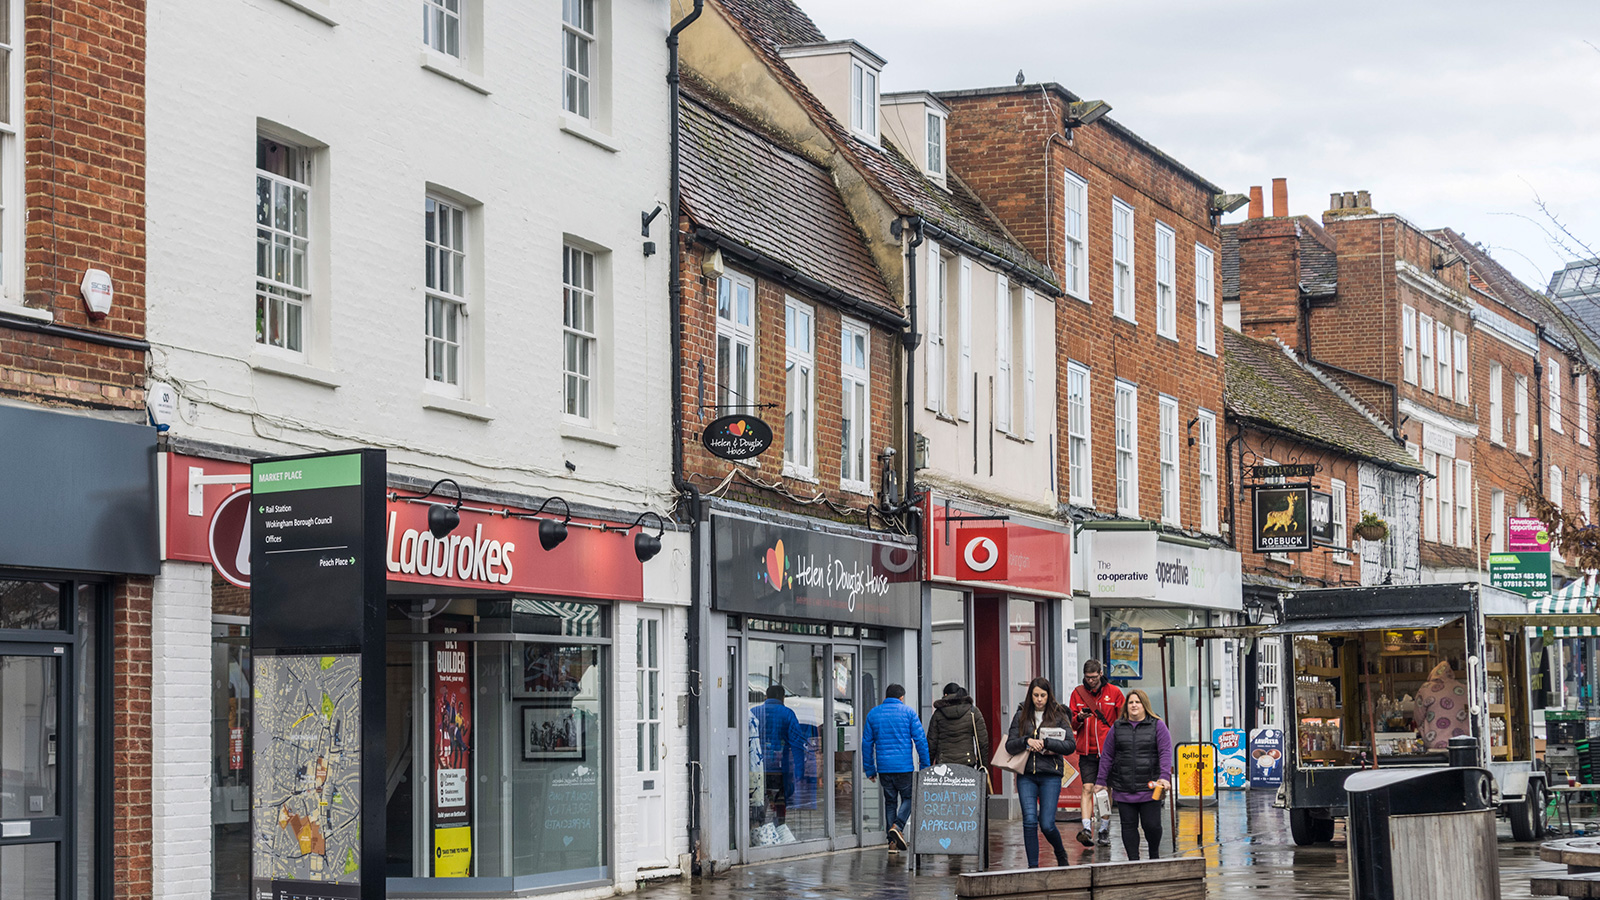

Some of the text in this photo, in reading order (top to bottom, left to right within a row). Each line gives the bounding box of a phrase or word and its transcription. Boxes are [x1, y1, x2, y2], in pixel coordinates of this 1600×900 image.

[710, 437, 763, 452] Helen & Douglas
[258, 470, 302, 483] MARKET PLACE
[275, 505, 292, 513] Station
[265, 516, 333, 529] Wokingham Borough Council
[265, 535, 282, 543] Offices
[1261, 536, 1303, 545] ROEBUCK
[387, 511, 515, 584] Ladbrokes
[319, 558, 348, 567] Peach Place
[1097, 560, 1111, 570] The
[1097, 571, 1149, 582] co-operative
[1155, 558, 1189, 589] -operative
[796, 554, 824, 589] Helen
[826, 554, 833, 597] &
[834, 559, 864, 612] Douglas
[865, 564, 889, 596] House
[1098, 583, 1115, 593] food
[437, 651, 466, 673] BUILDER
[1182, 752, 1209, 760] Rolloer
[923, 790, 977, 802] DONATIONS
[923, 803, 976, 817] GREATLY
[920, 819, 978, 832] APPRECIATED
